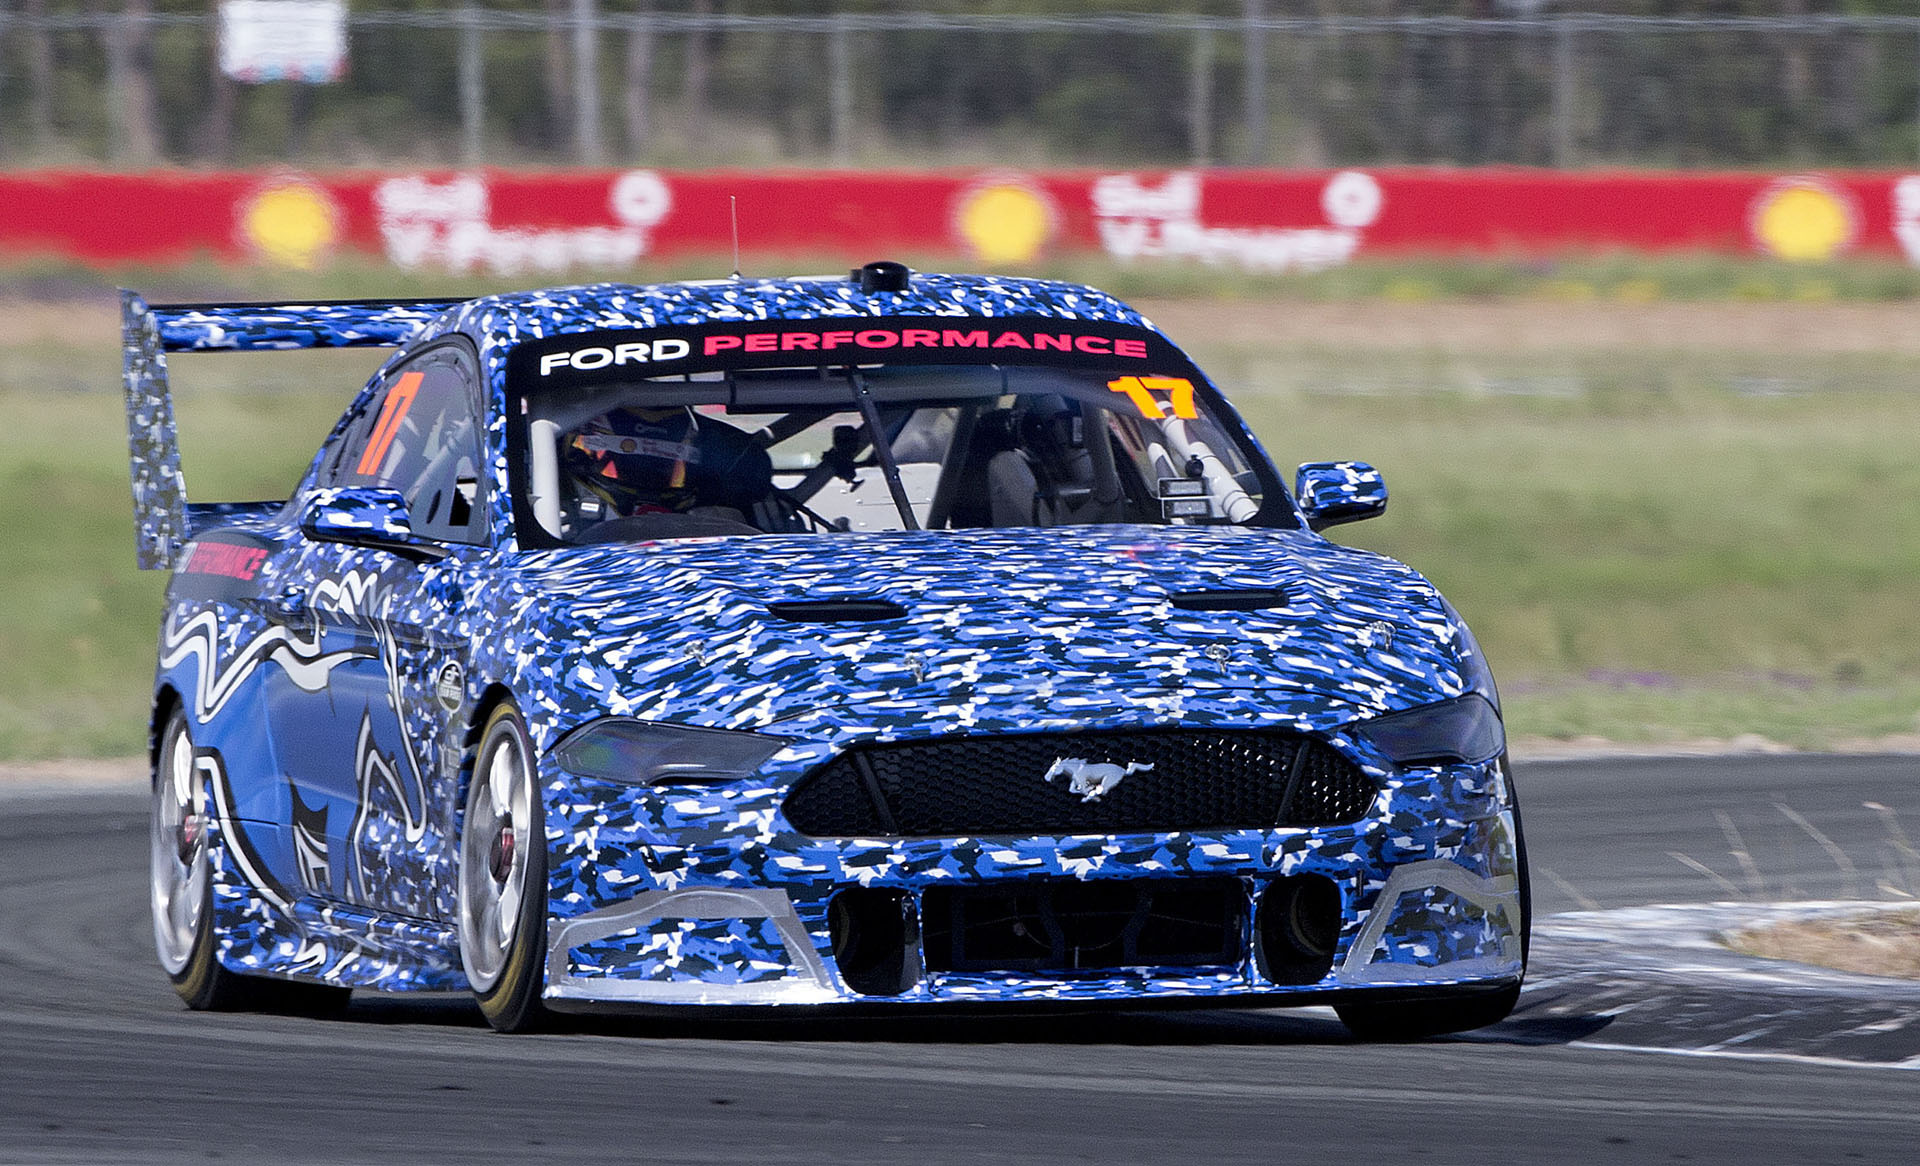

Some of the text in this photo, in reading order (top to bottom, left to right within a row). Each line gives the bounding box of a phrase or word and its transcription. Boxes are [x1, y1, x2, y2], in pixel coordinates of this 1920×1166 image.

[540, 329, 1148, 376] FORD PERFORMANCE
[1107, 375, 1199, 420] 17
